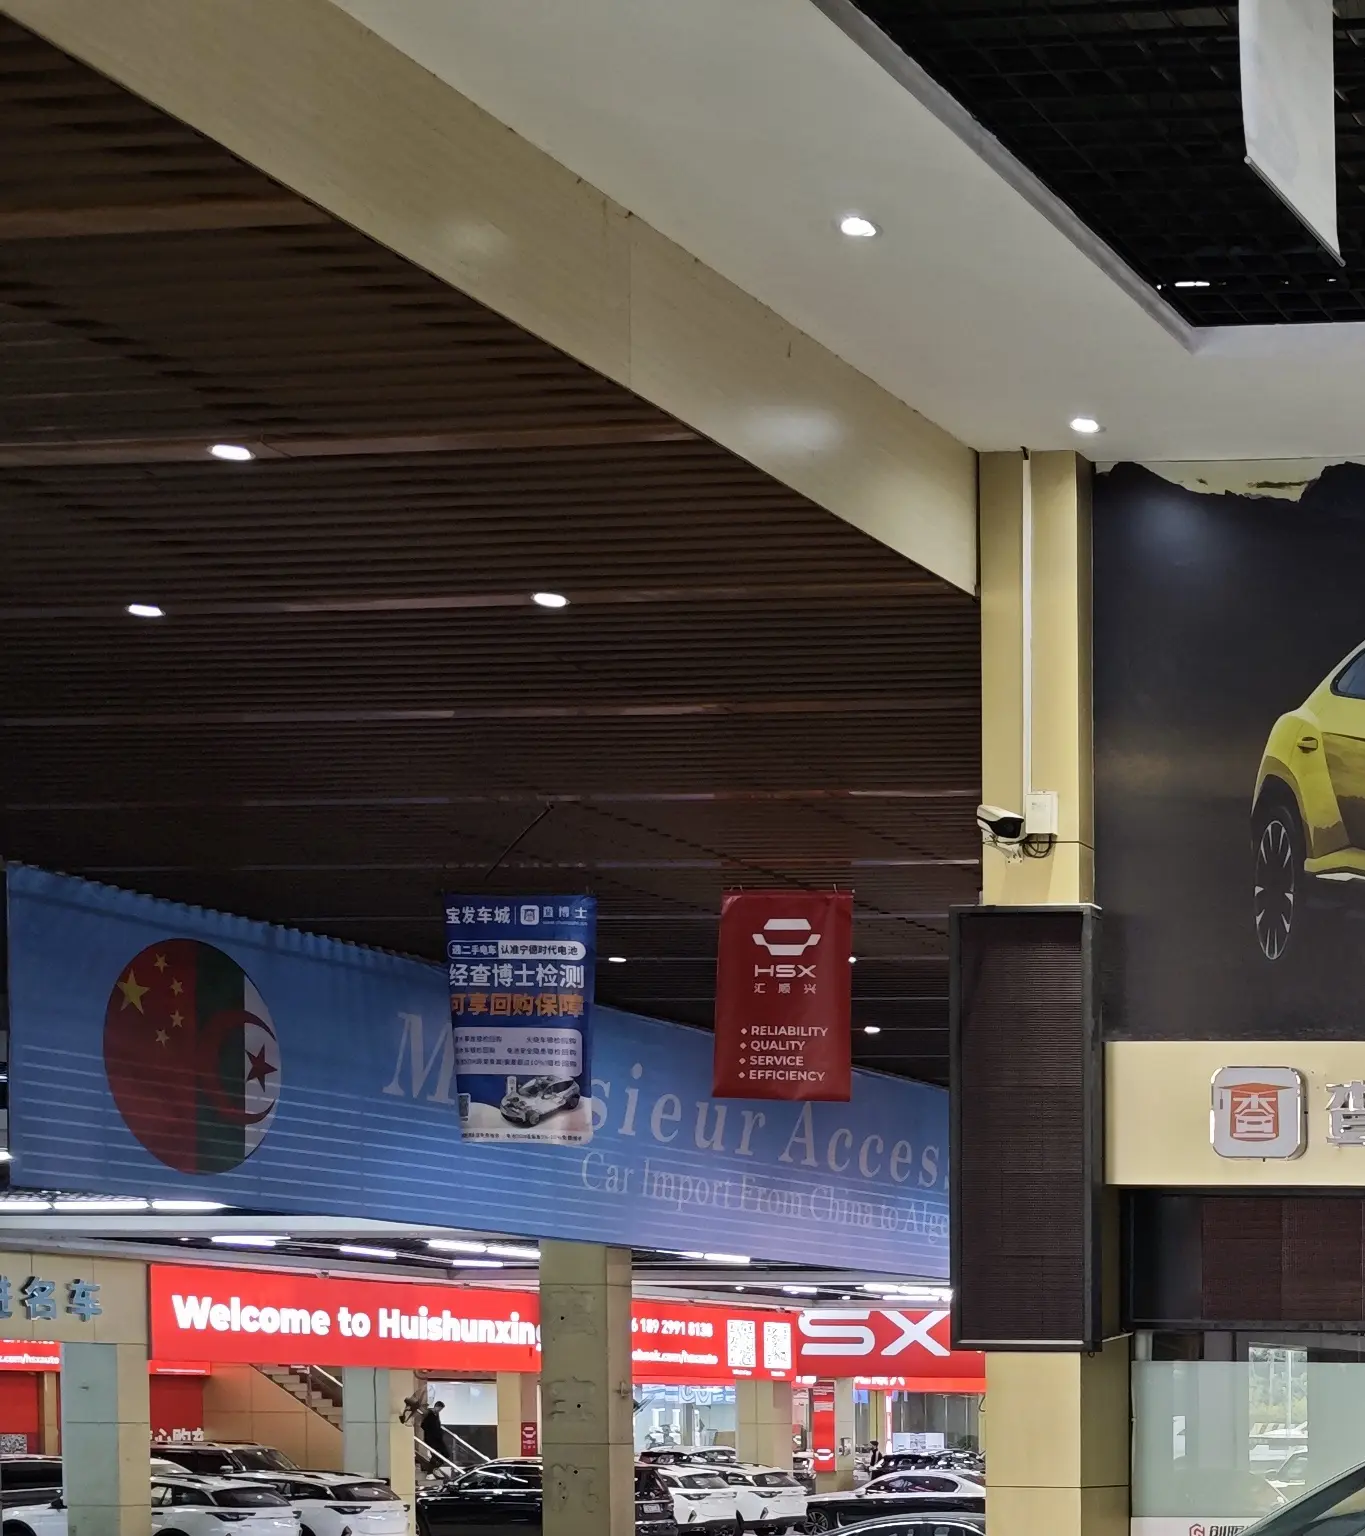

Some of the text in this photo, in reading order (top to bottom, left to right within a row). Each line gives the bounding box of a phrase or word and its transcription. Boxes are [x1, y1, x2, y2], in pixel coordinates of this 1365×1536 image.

[445, 905, 511, 925] 宝发车城
[449, 963, 585, 989] 经查博士检测
[754, 964, 817, 978] HSX
[754, 983, 817, 995] 汇顺兴
[451, 992, 584, 1018] 可享回购保障
[751, 1025, 828, 1037] RELIABILITY
[750, 1040, 805, 1052] QUALITY
[749, 1055, 804, 1066] SERVICE
[749, 1070, 826, 1081] EFFICIENCY
[778, 1100, 950, 1190] Acces
[581, 1151, 634, 1193] Car
[642, 1159, 733, 1213] Import
[740, 1173, 803, 1217] From
[809, 1185, 873, 1228] China
[171, 1294, 331, 1335] Welcome
[337, 1306, 371, 1338] to
